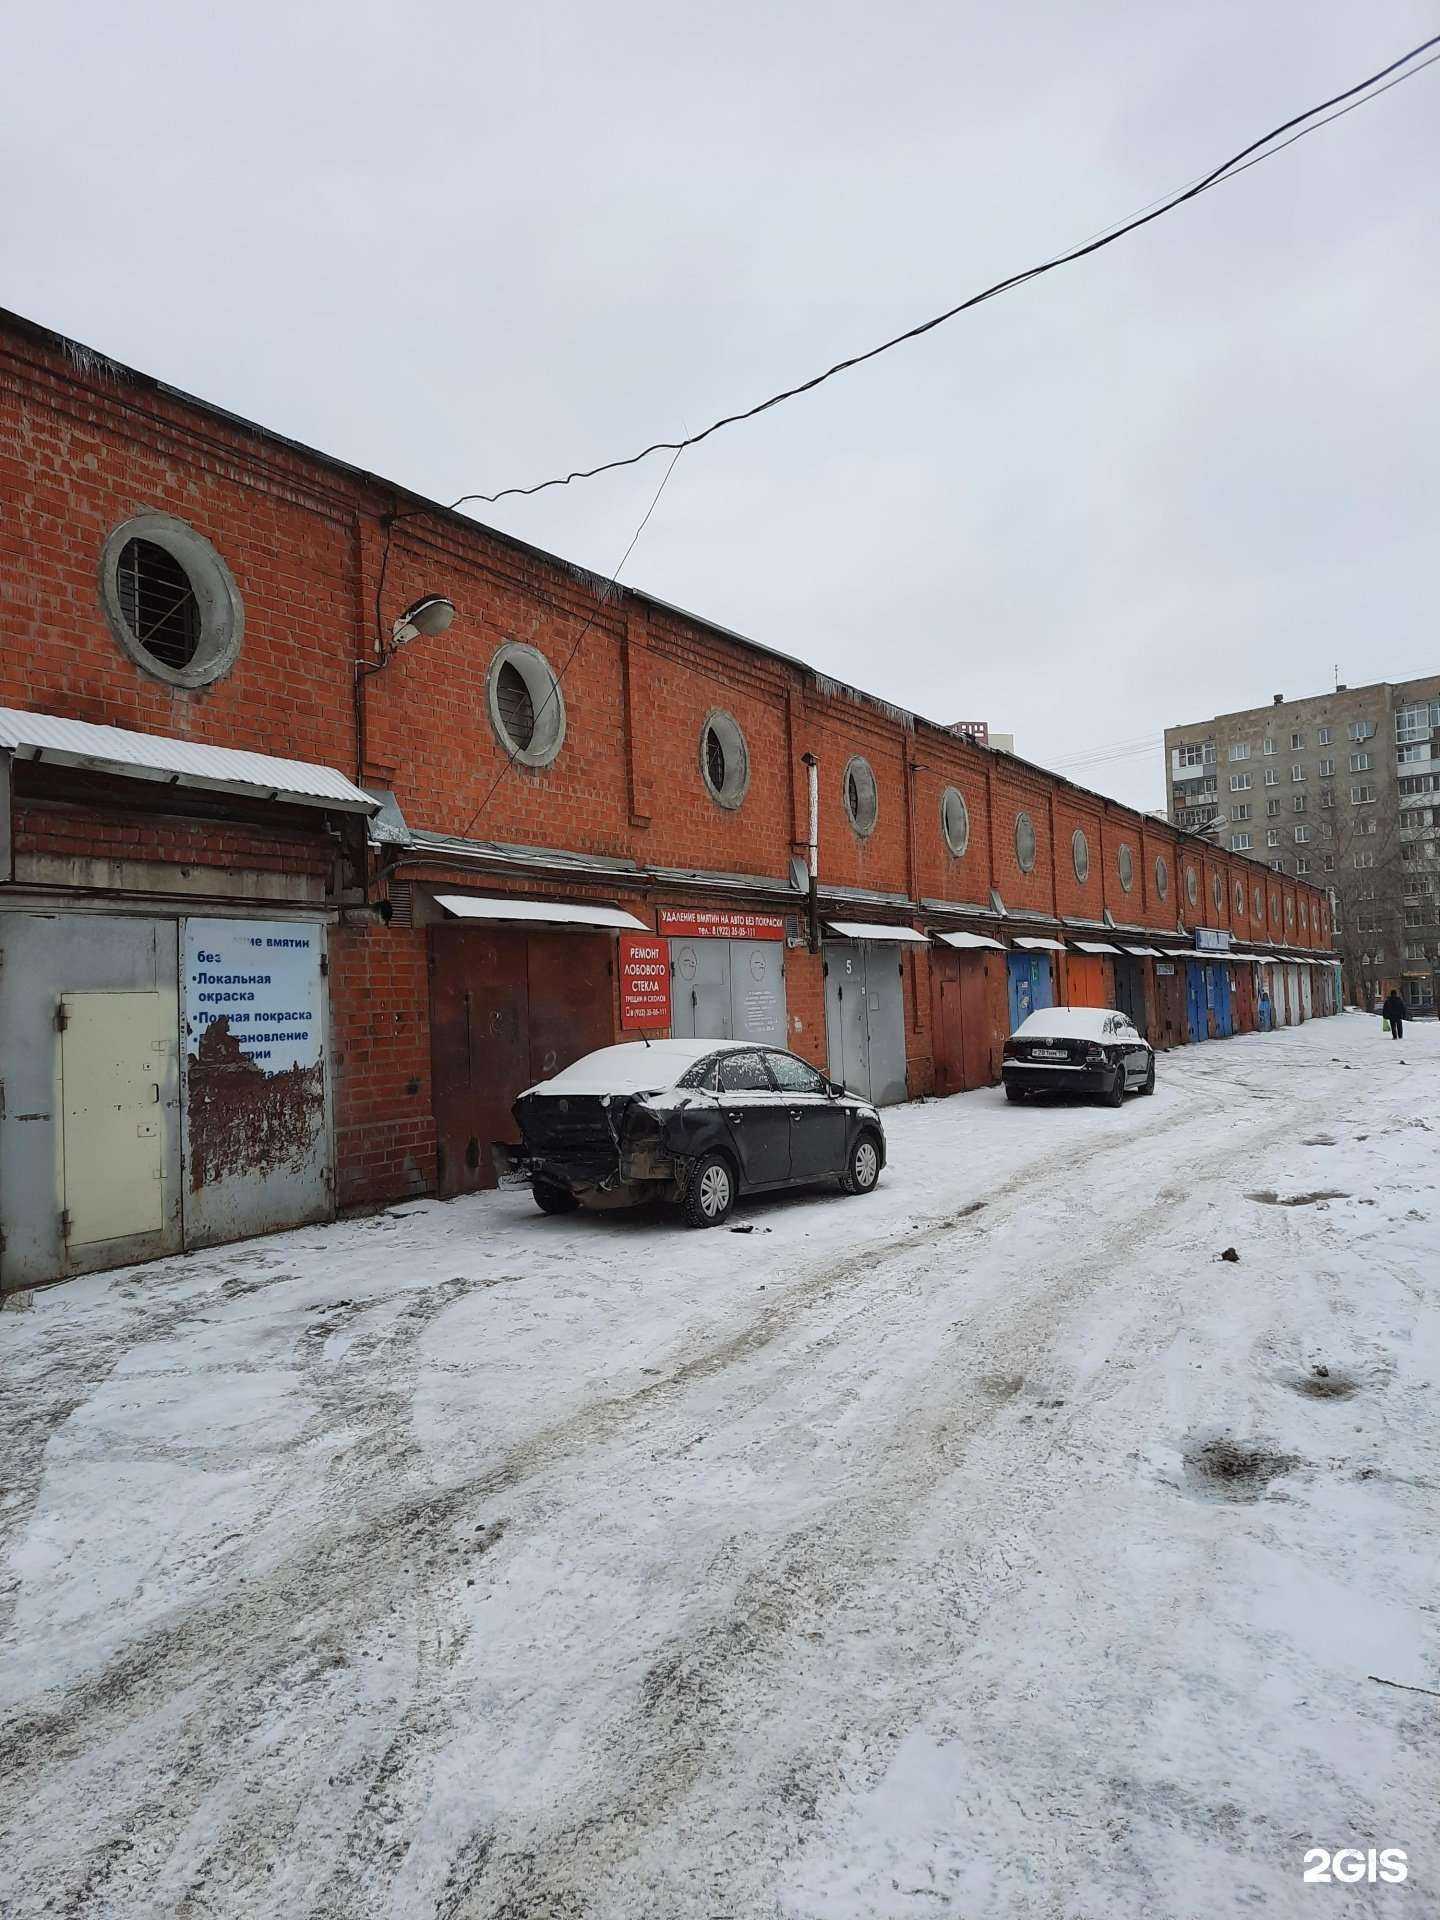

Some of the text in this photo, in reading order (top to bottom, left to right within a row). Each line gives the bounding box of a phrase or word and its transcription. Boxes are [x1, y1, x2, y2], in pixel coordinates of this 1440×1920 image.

[662, 911, 783, 928] УДАЛЕНИЕ ВМЯТИН НА АВТО БЕЗ ПОКРАСКИ
[266, 937, 310, 948] вмятин
[630, 947, 660, 959] РЕМОНТ
[624, 964, 666, 976] ЛОБОВОГО
[846, 959, 852, 974] 5
[197, 972, 272, 985] Локальная
[631, 980, 660, 992] СТЕКЛА
[198, 992, 255, 1005] окраска
[254, 1010, 313, 1024] покраска
